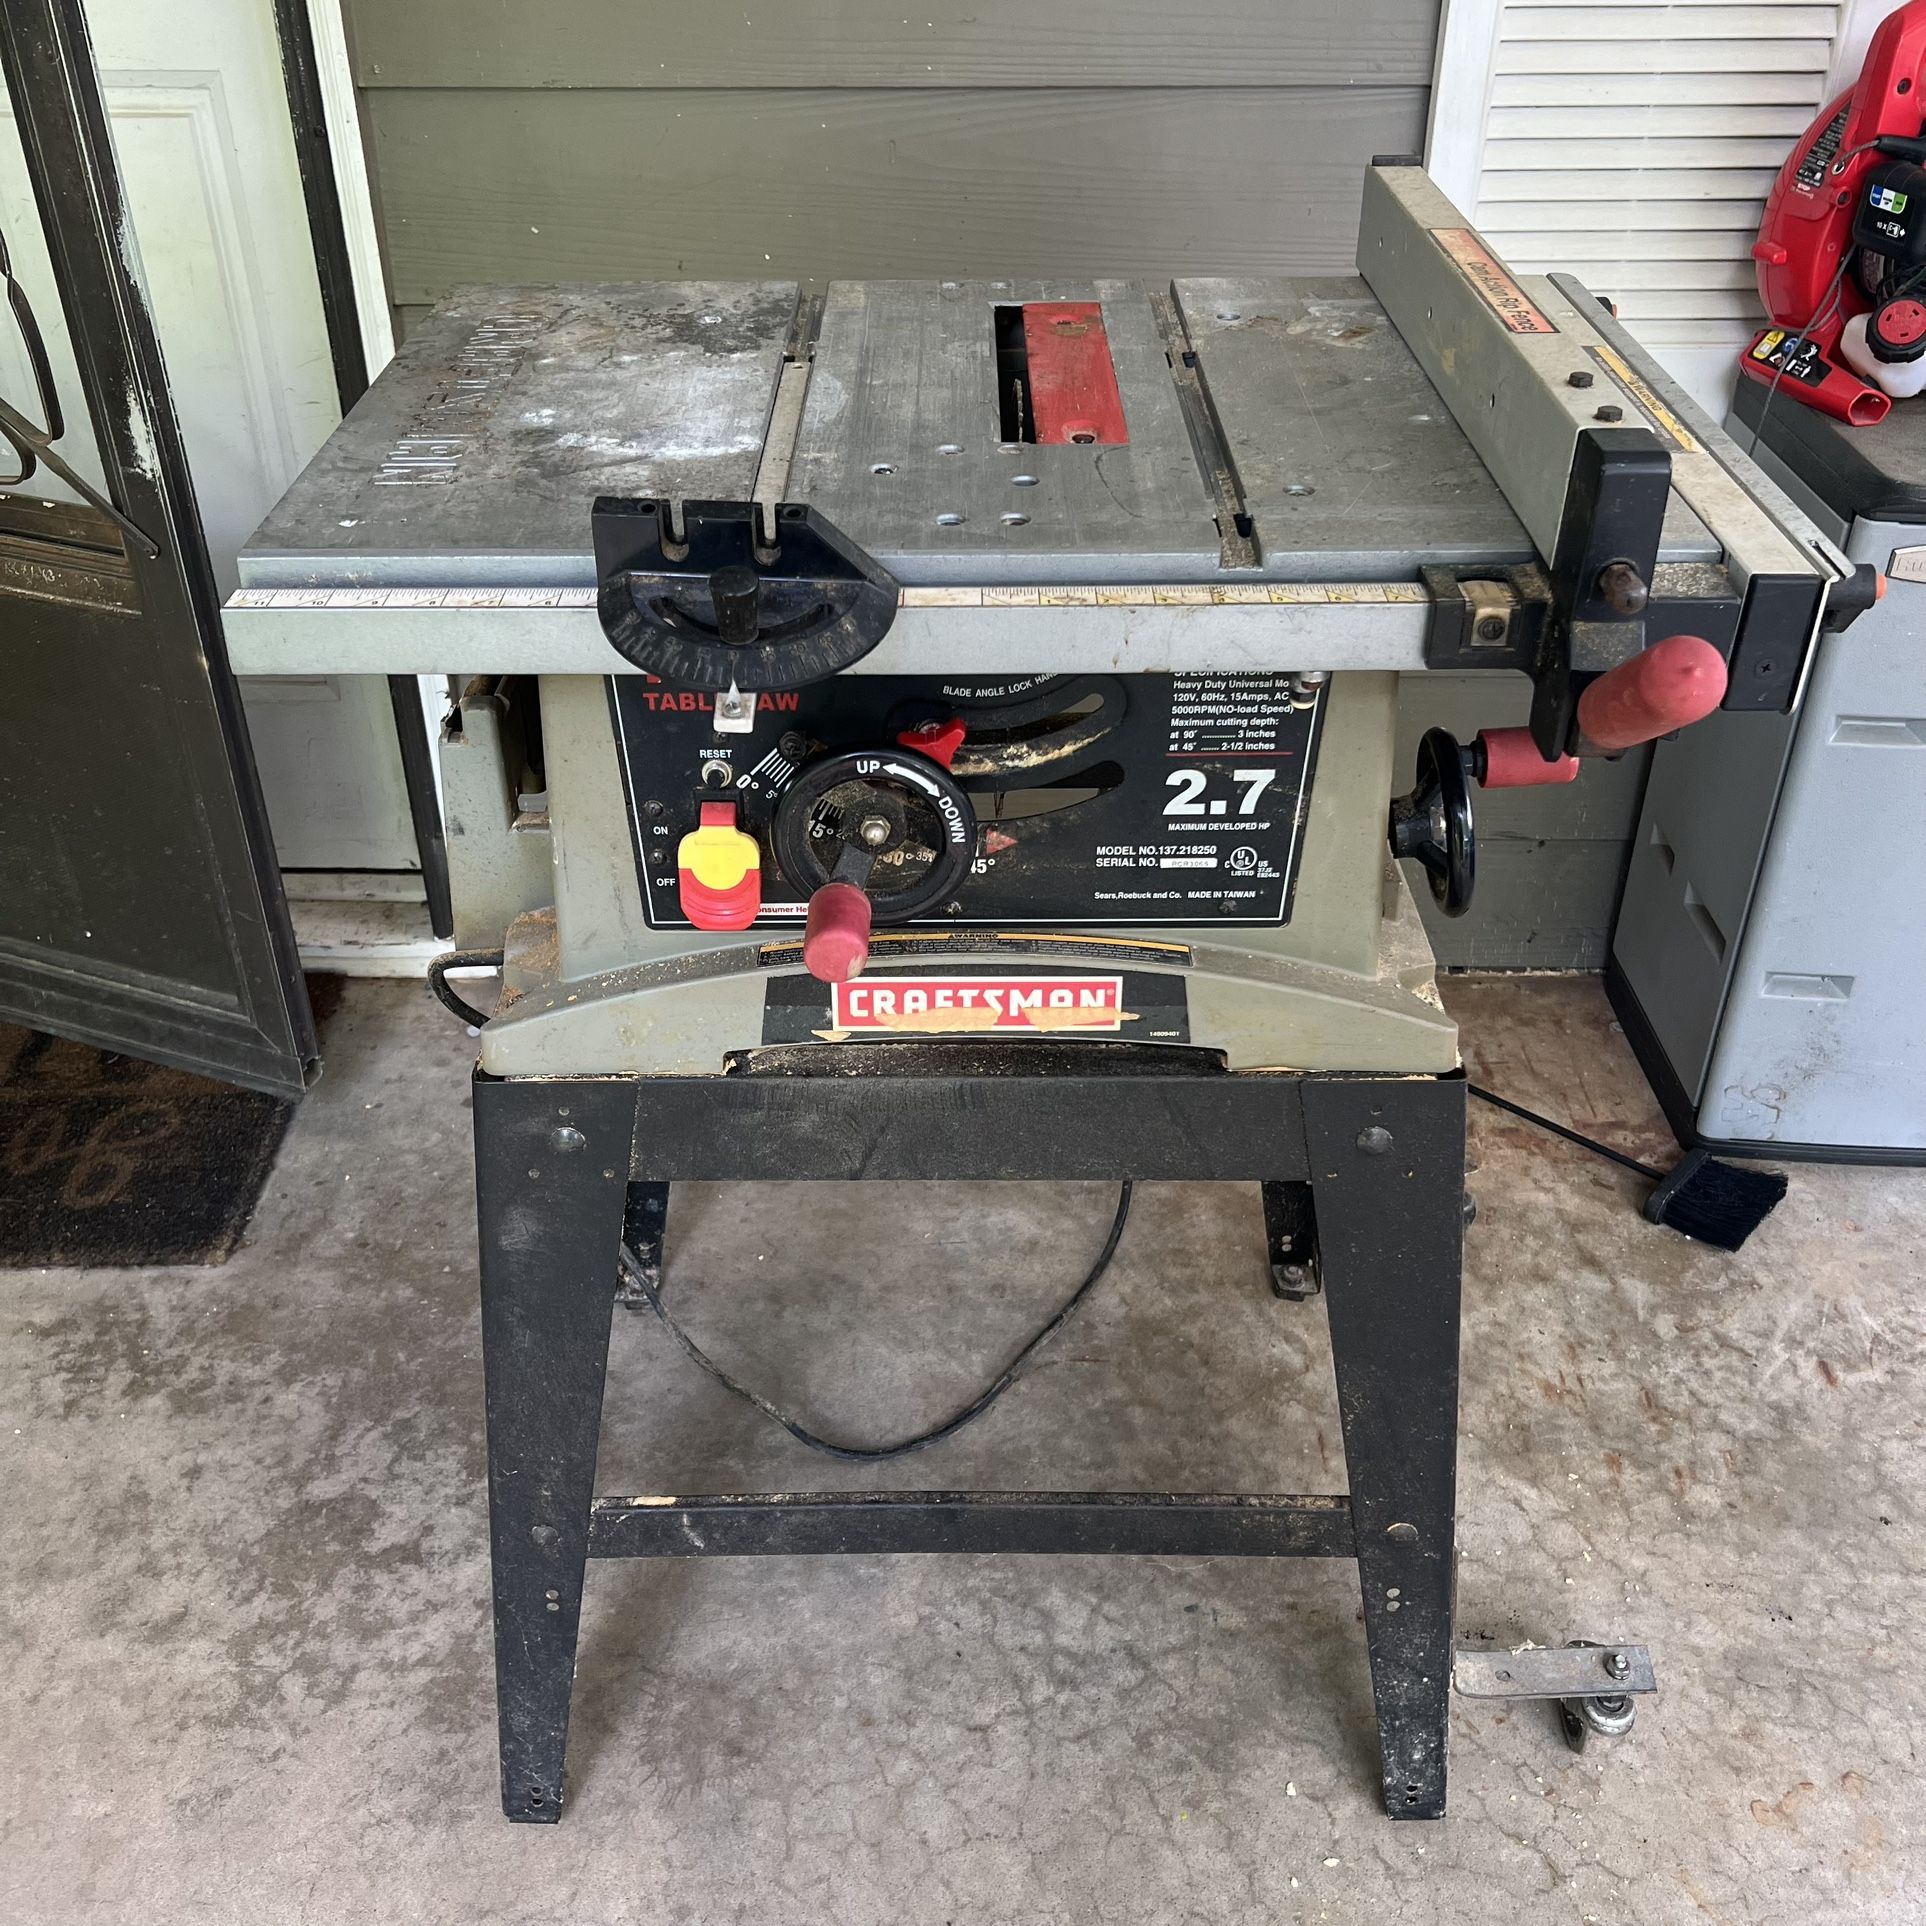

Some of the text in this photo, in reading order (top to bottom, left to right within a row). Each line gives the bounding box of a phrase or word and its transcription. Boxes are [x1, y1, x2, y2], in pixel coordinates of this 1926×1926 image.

[1507, 310, 1538, 331] Fence
[942, 685, 972, 697] BLADE
[975, 687, 1005, 697] ANGLE
[1008, 680, 1033, 694] LOCK
[1173, 679, 1290, 690] Heavy Duty Universal Mo
[643, 692, 800, 711] TABL AW
[1173, 692, 1290, 702] 120V, 60Hz, 15Amps, AC
[1172, 704, 1294, 715] 5000RPM(NO-load Speed)
[1171, 717, 1280, 727] Maximum cutting depth:
[1170, 731, 1180, 739] at
[1237, 730, 1244, 738] 3
[1246, 729, 1276, 738] inches
[1169, 743, 1179, 751] at
[1221, 742, 1244, 751] 2-1/2
[1245, 742, 1276, 750] inches
[699, 749, 733, 759] RESET
[1162, 769, 1276, 815] 2.7
[856, 760, 966, 844] UP DOWN
[653, 826, 669, 835] ON
[1168, 822, 1271, 831] MAXIMUM DEVELOPED HP
[1096, 846, 1136, 855] MODEL
[1095, 858, 1137, 867] SERIAL
[1138, 857, 1159, 867] NO.
[1258, 860, 1269, 868] US
[656, 878, 676, 887] OFF
[1094, 892, 1151, 900] Sears,Roebuck
[796, 905, 808, 913] He
[849, 988, 1106, 1017] CRAFTSMAN
